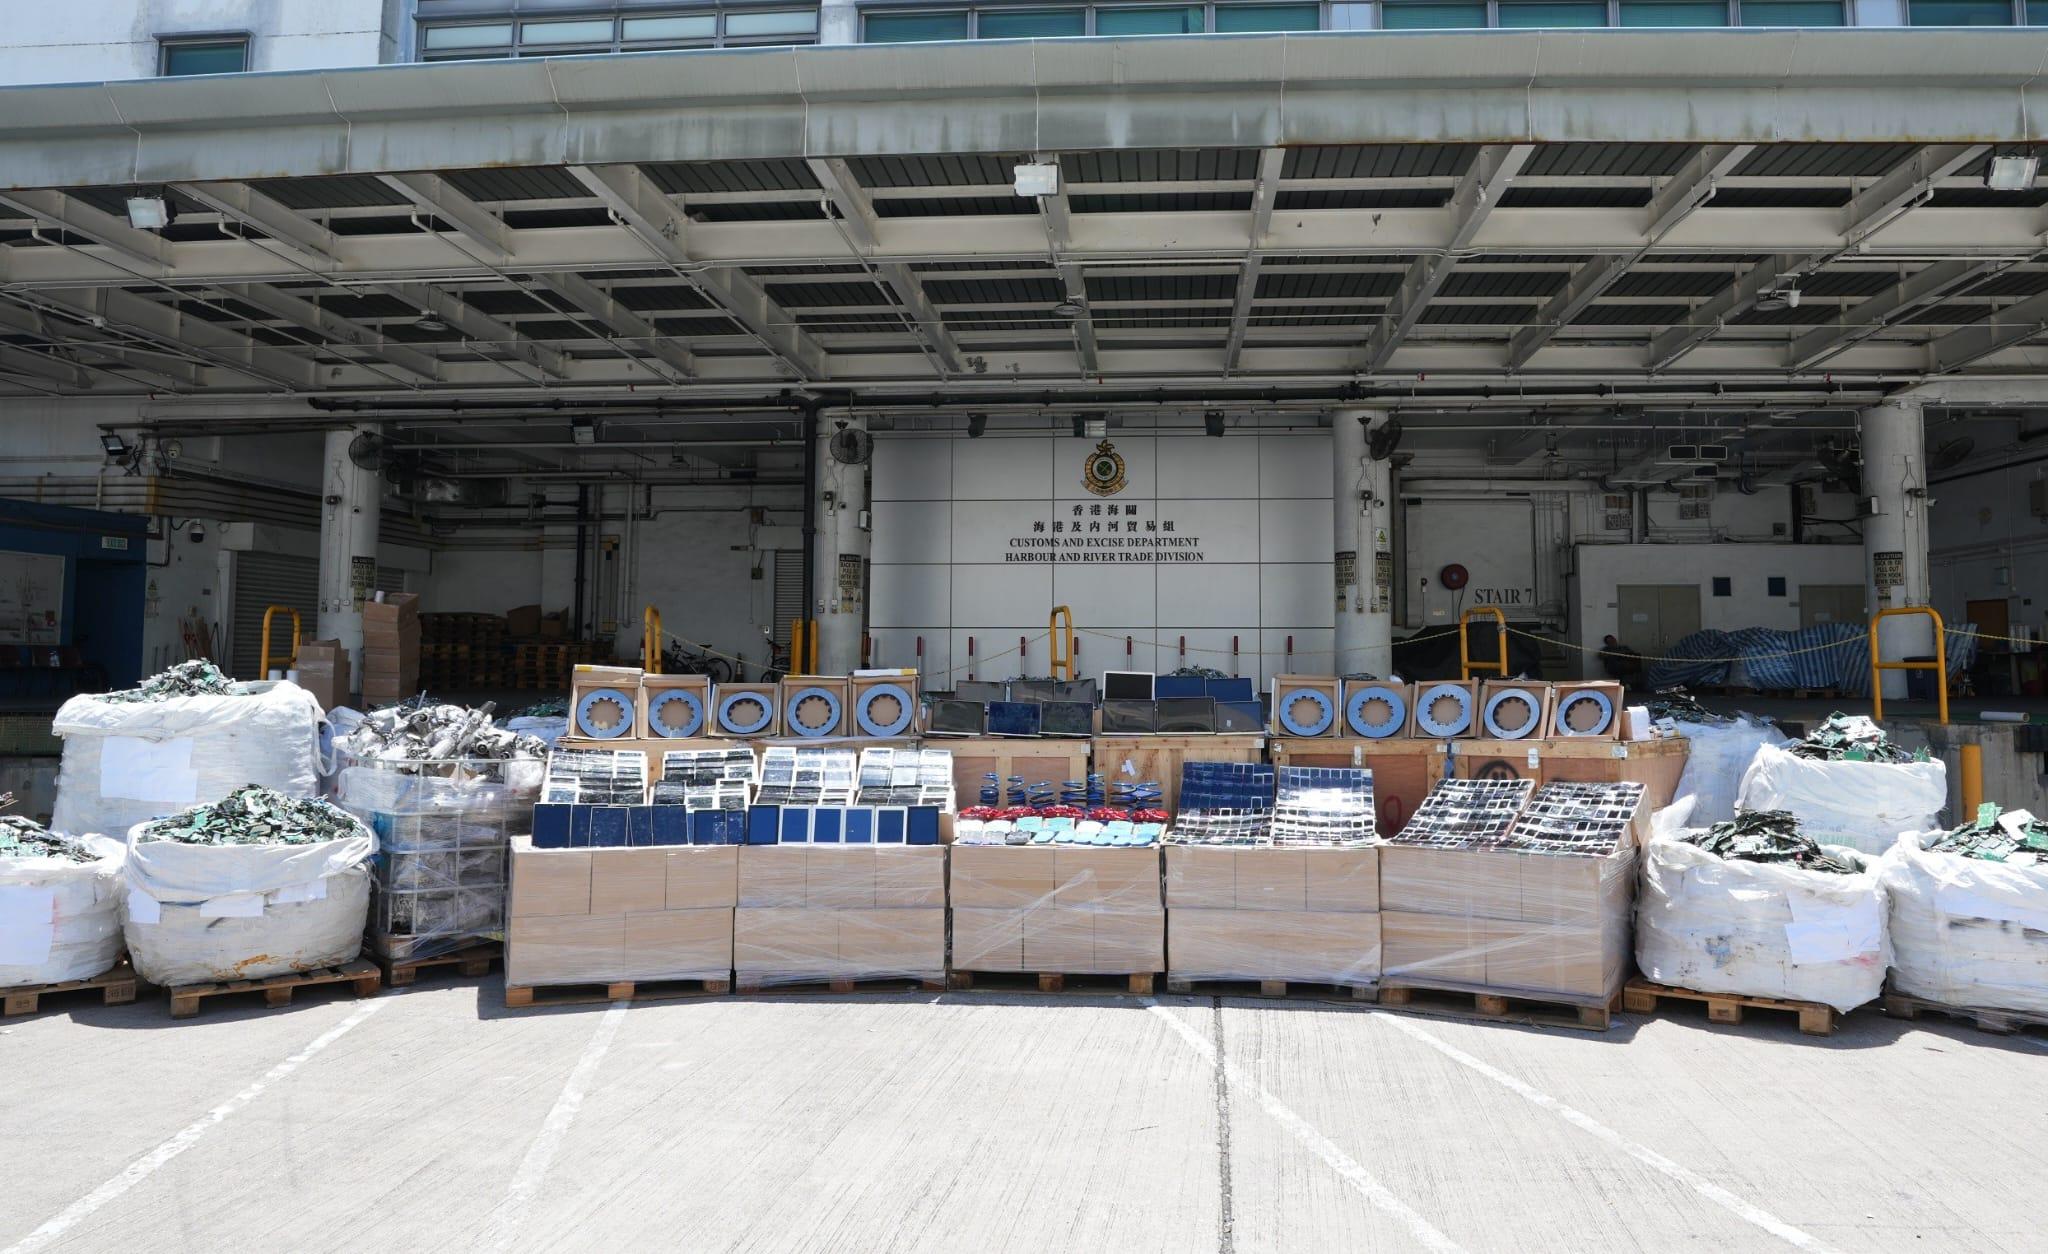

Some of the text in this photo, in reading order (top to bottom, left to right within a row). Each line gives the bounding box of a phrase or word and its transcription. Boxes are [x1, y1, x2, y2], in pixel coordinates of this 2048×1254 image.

[1072, 504, 1137, 516] 香港海關
[1009, 537, 1200, 548] CUSTOMS AND EXCISE DEPARTMENT
[1005, 551, 1204, 562] HARBOUR AND RIVER TRADE DIVISION
[1474, 588, 1532, 604] STAIR 7
